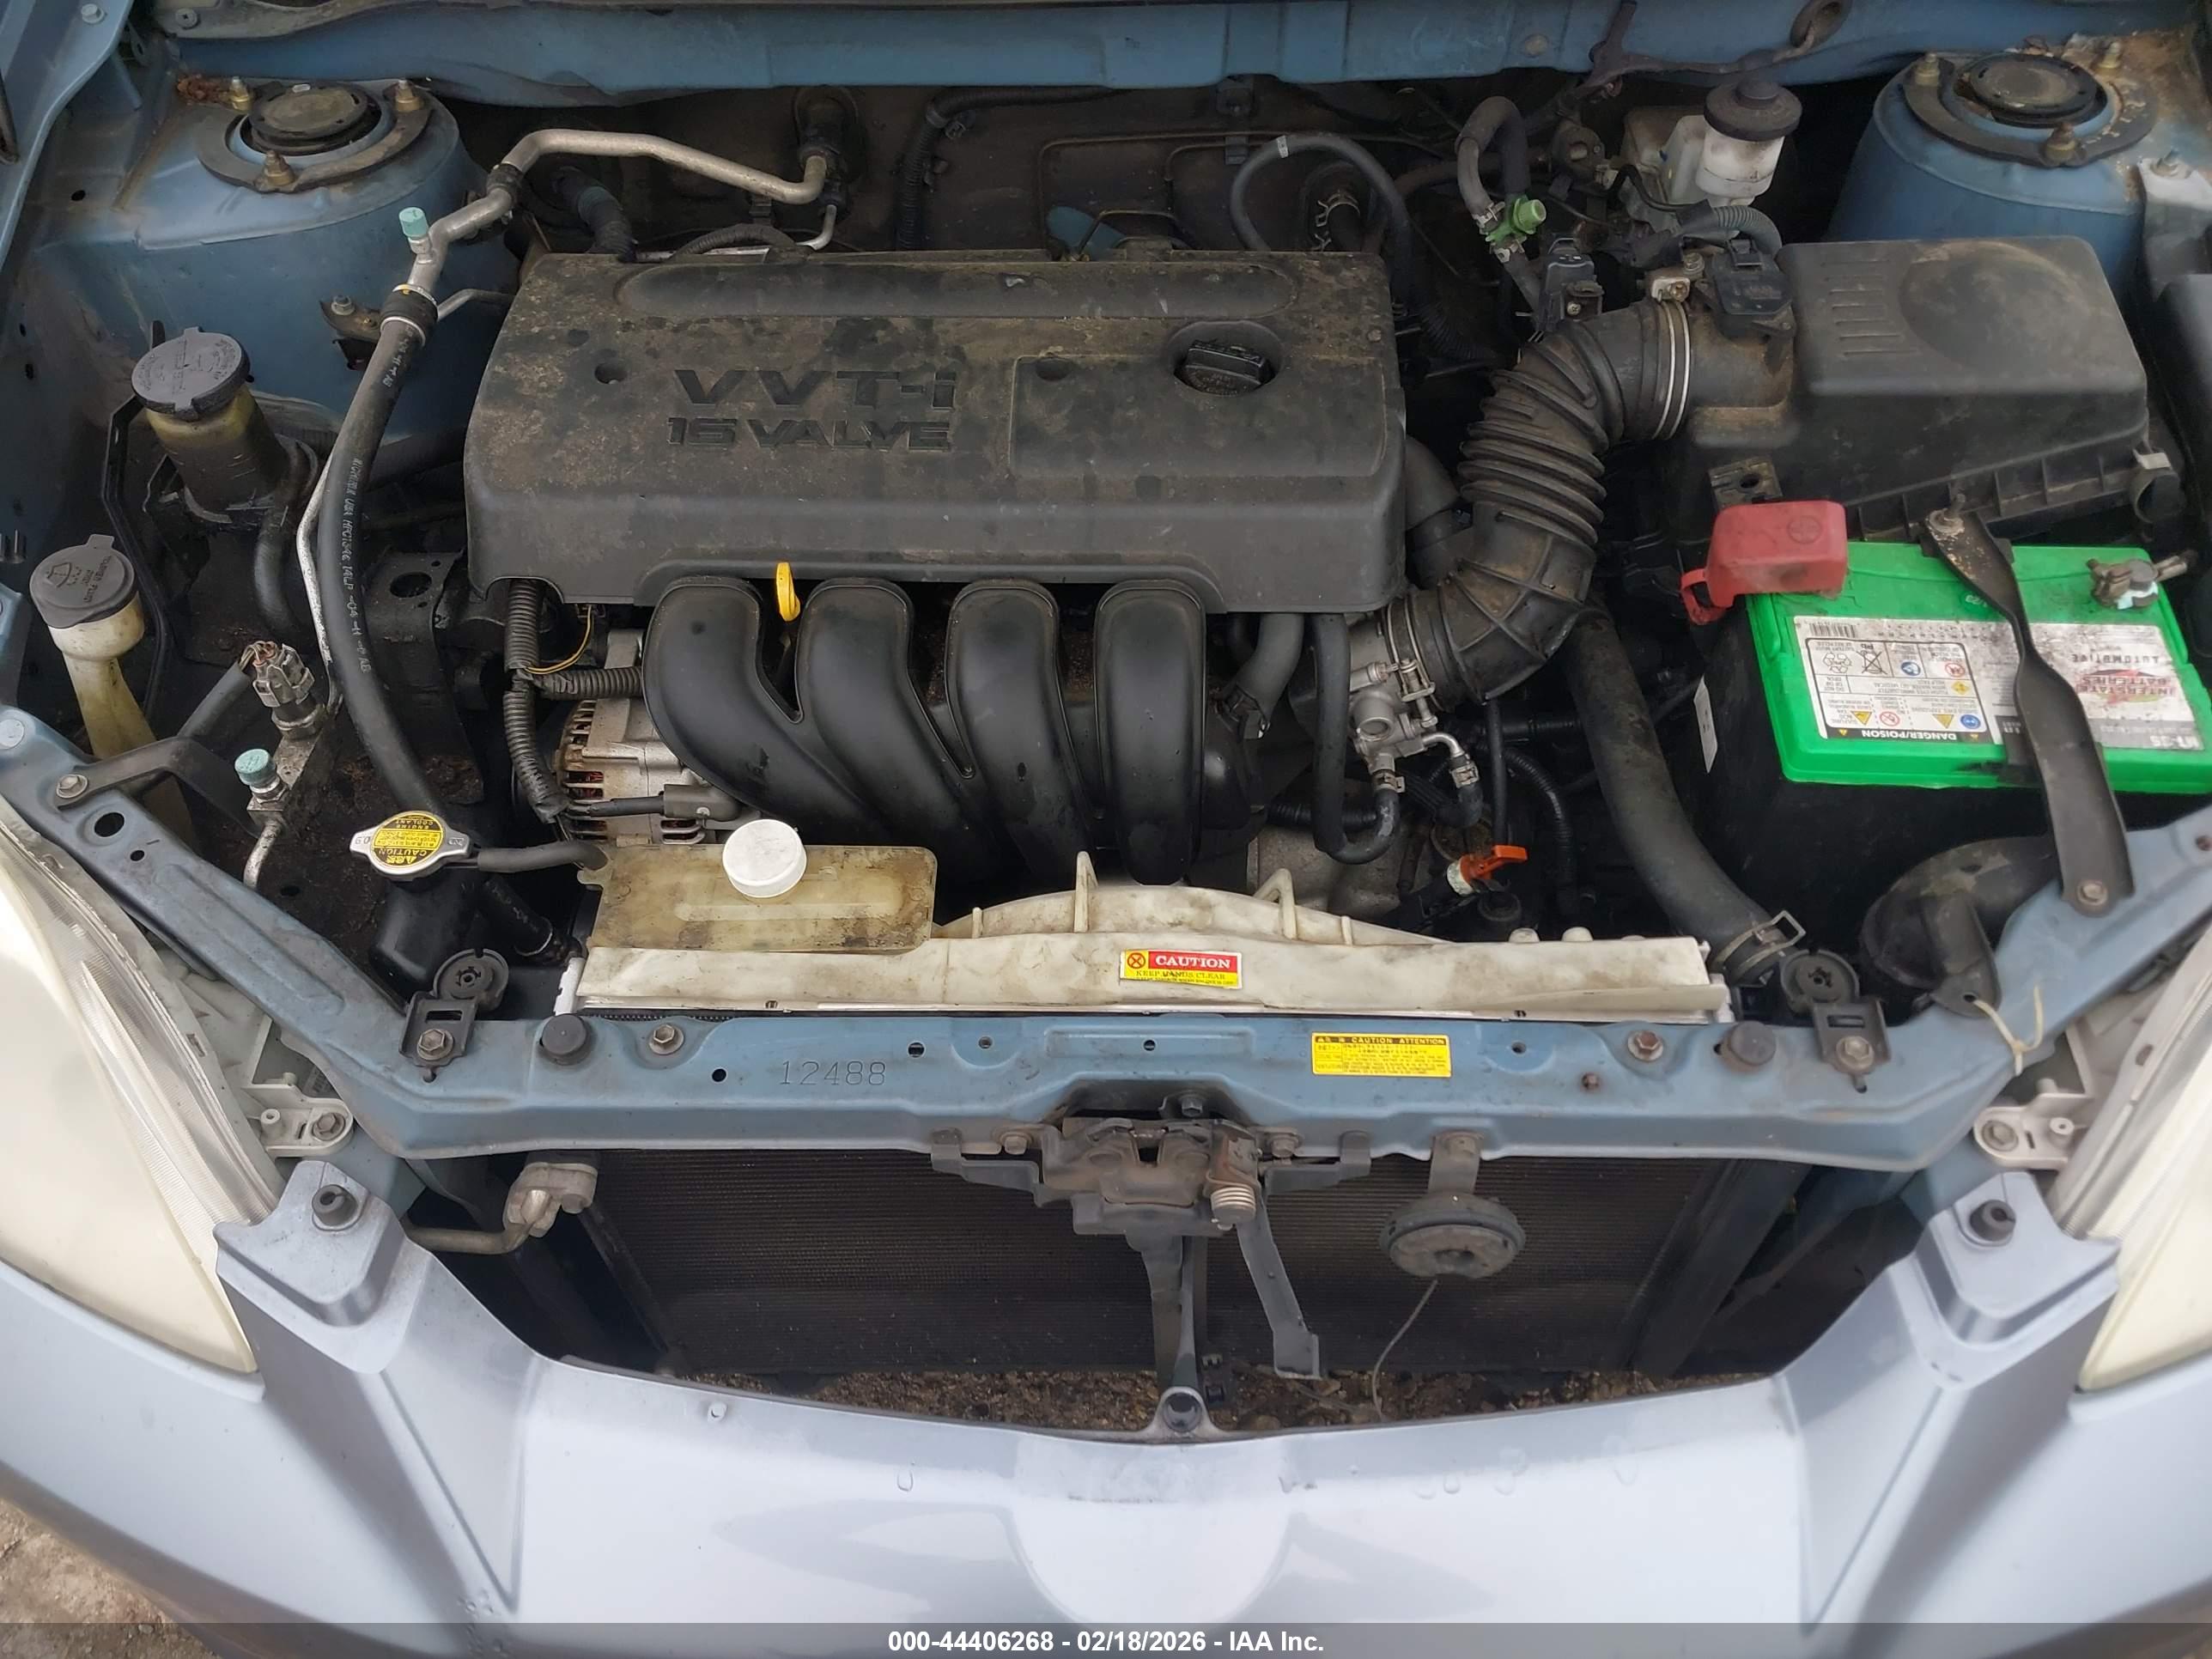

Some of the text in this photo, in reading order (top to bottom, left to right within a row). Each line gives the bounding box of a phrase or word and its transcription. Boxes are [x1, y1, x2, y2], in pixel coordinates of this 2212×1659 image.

[674, 368, 957, 411] VVT-i
[745, 418, 951, 452] VALVE
[2071, 653, 2160, 664] AUTOMOTIVE
[2082, 676, 2166, 685] BATTERIES
[2079, 684, 2173, 696] INTERSTATE
[1862, 730, 1957, 740] DANGER/POISON
[379, 848, 428, 857] CAUTION
[1155, 955, 1231, 969] CAUTION
[1136, 969, 1160, 977] KEEP
[1195, 971, 1225, 980] CLEAR
[780, 1060, 886, 1086] 12488
